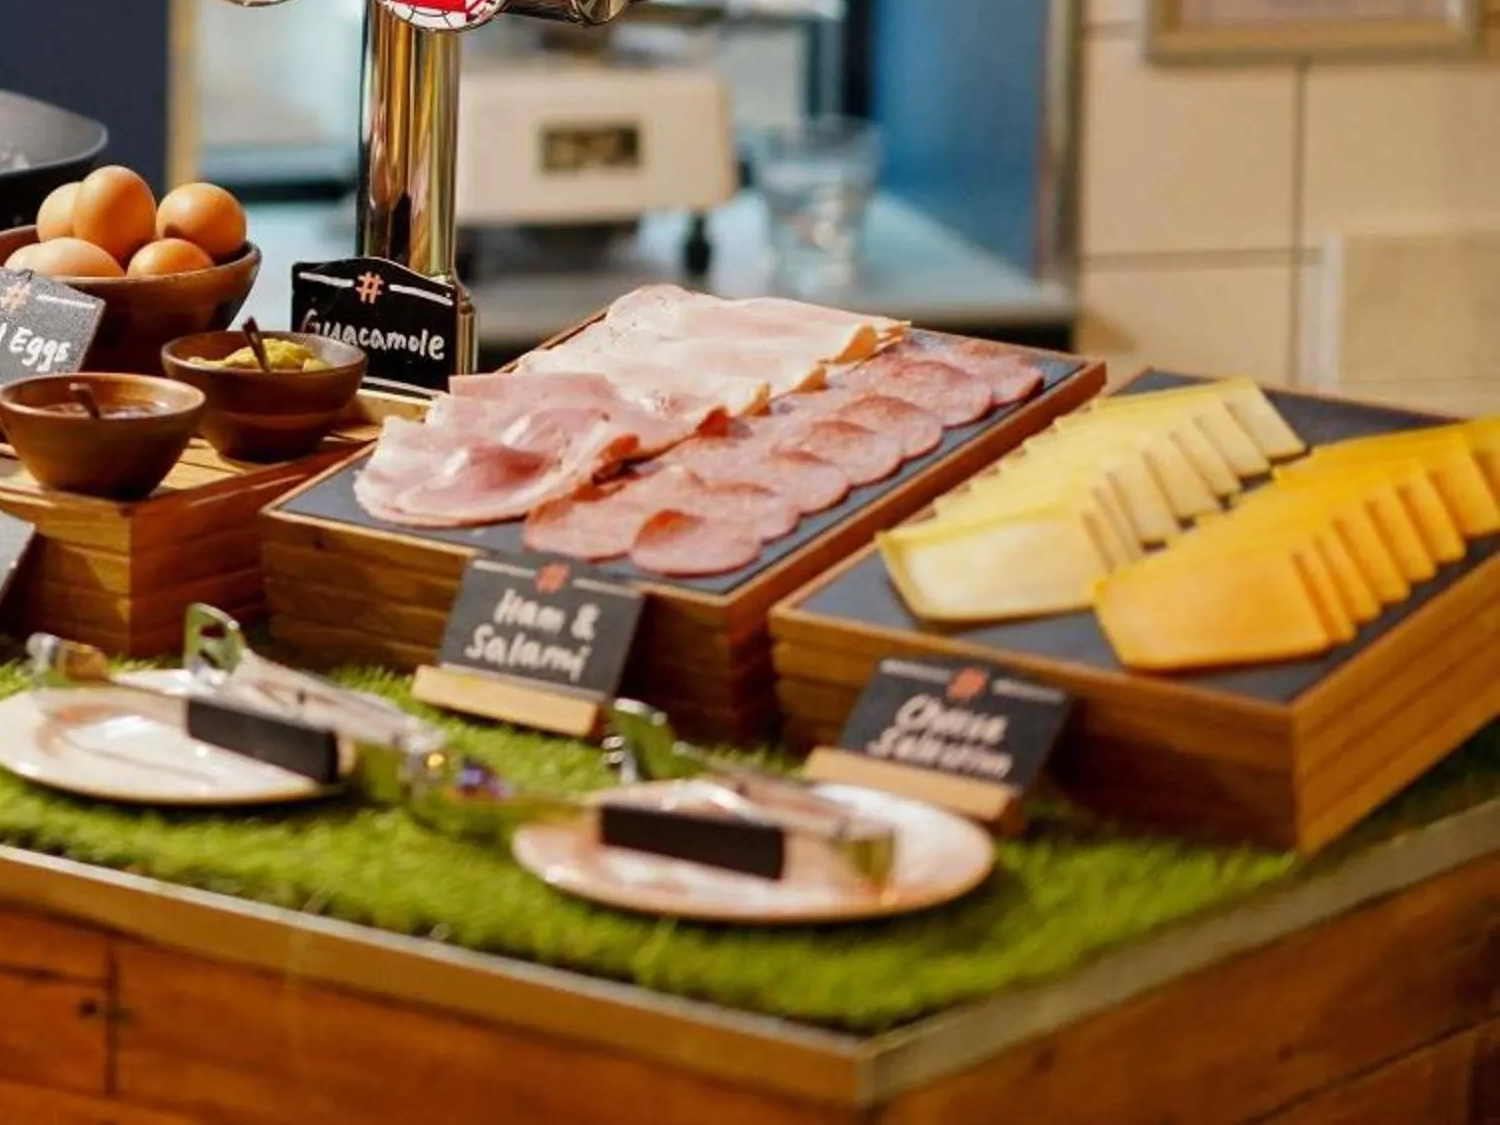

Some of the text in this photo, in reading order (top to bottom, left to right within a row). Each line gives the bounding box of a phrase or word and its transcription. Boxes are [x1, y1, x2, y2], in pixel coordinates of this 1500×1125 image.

[8, 326, 72, 373] Eggs
[493, 587, 567, 634] Ham
[463, 624, 592, 684] Salami
